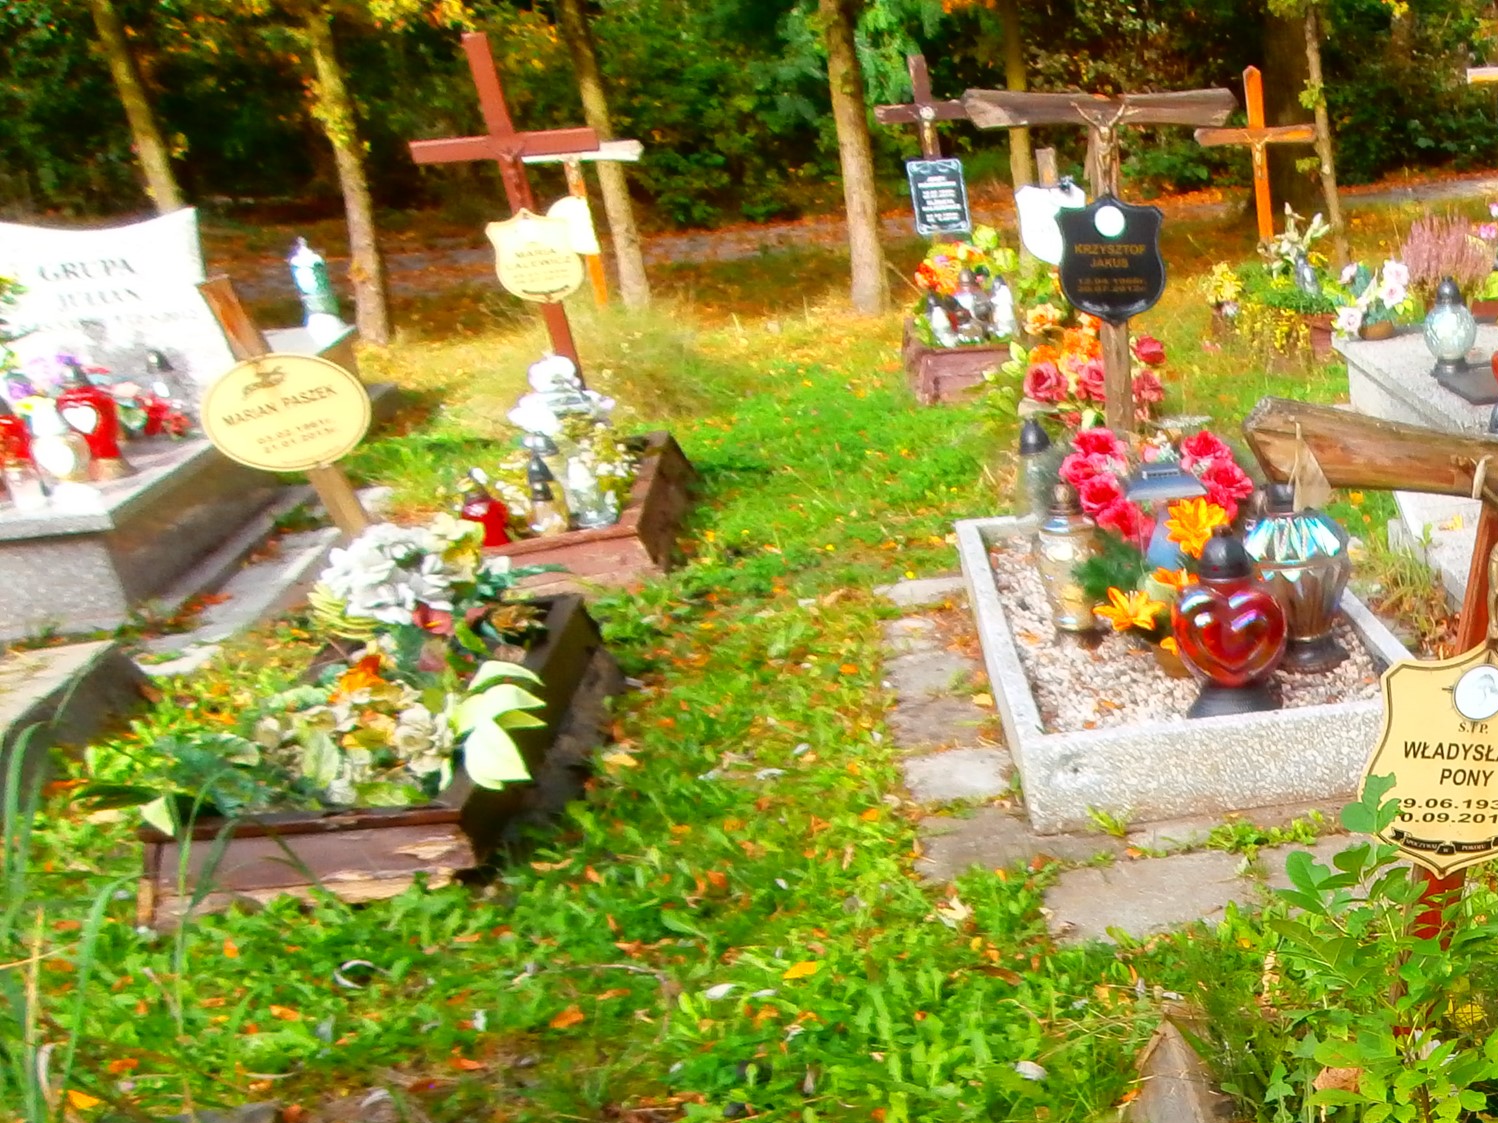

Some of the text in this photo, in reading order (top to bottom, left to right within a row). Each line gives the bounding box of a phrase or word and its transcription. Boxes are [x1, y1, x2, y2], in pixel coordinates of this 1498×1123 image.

[1074, 243, 1147, 256] KRZYSZTOF
[221, 402, 280, 427] MARIAN
[1439, 767, 1495, 788] PONY
